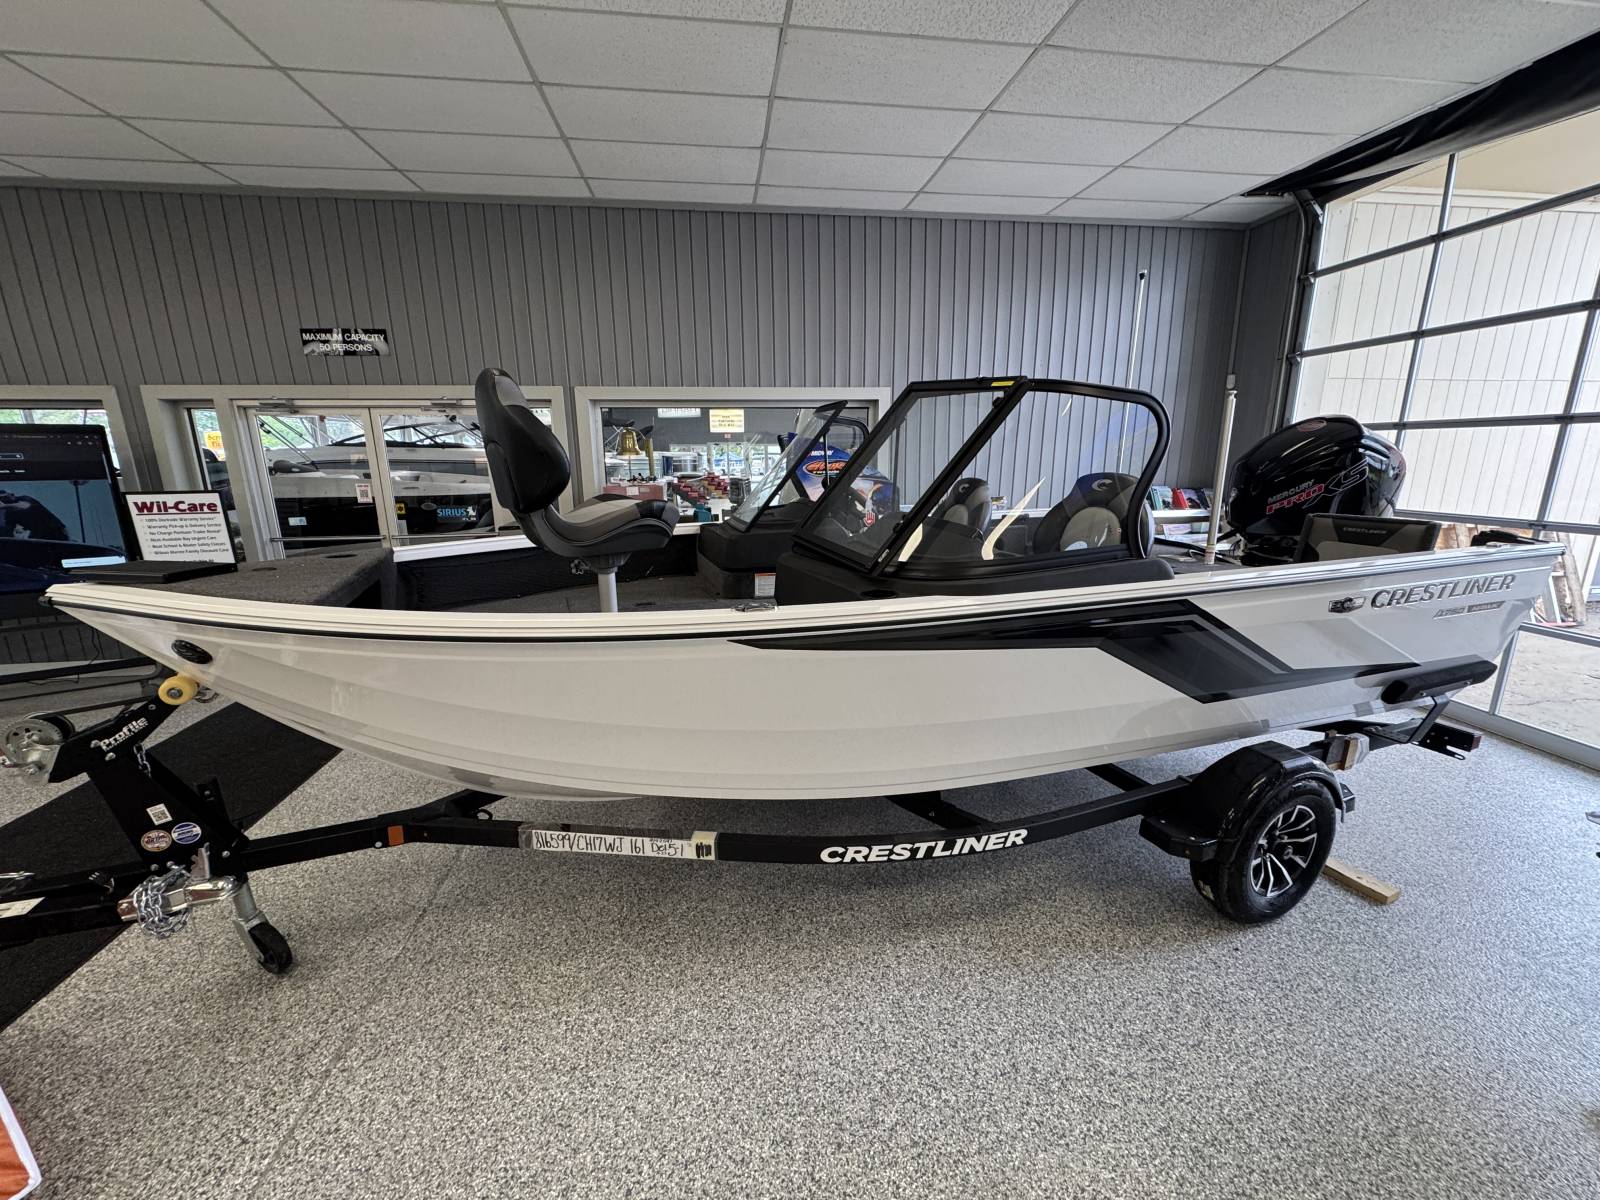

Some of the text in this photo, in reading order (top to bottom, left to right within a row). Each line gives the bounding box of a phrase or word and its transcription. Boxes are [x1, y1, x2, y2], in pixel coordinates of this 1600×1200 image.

[302, 333, 385, 342] MAXIMUM CAPACITY
[319, 343, 373, 352] 50 PERSONS
[1267, 479, 1315, 504] MERCURY
[133, 500, 218, 513] Wil-Care
[437, 508, 467, 517] SIRIUS
[1370, 573, 1517, 610] CRESTLINER
[100, 717, 148, 752] Profile
[819, 828, 1029, 864] CRESTLINER
